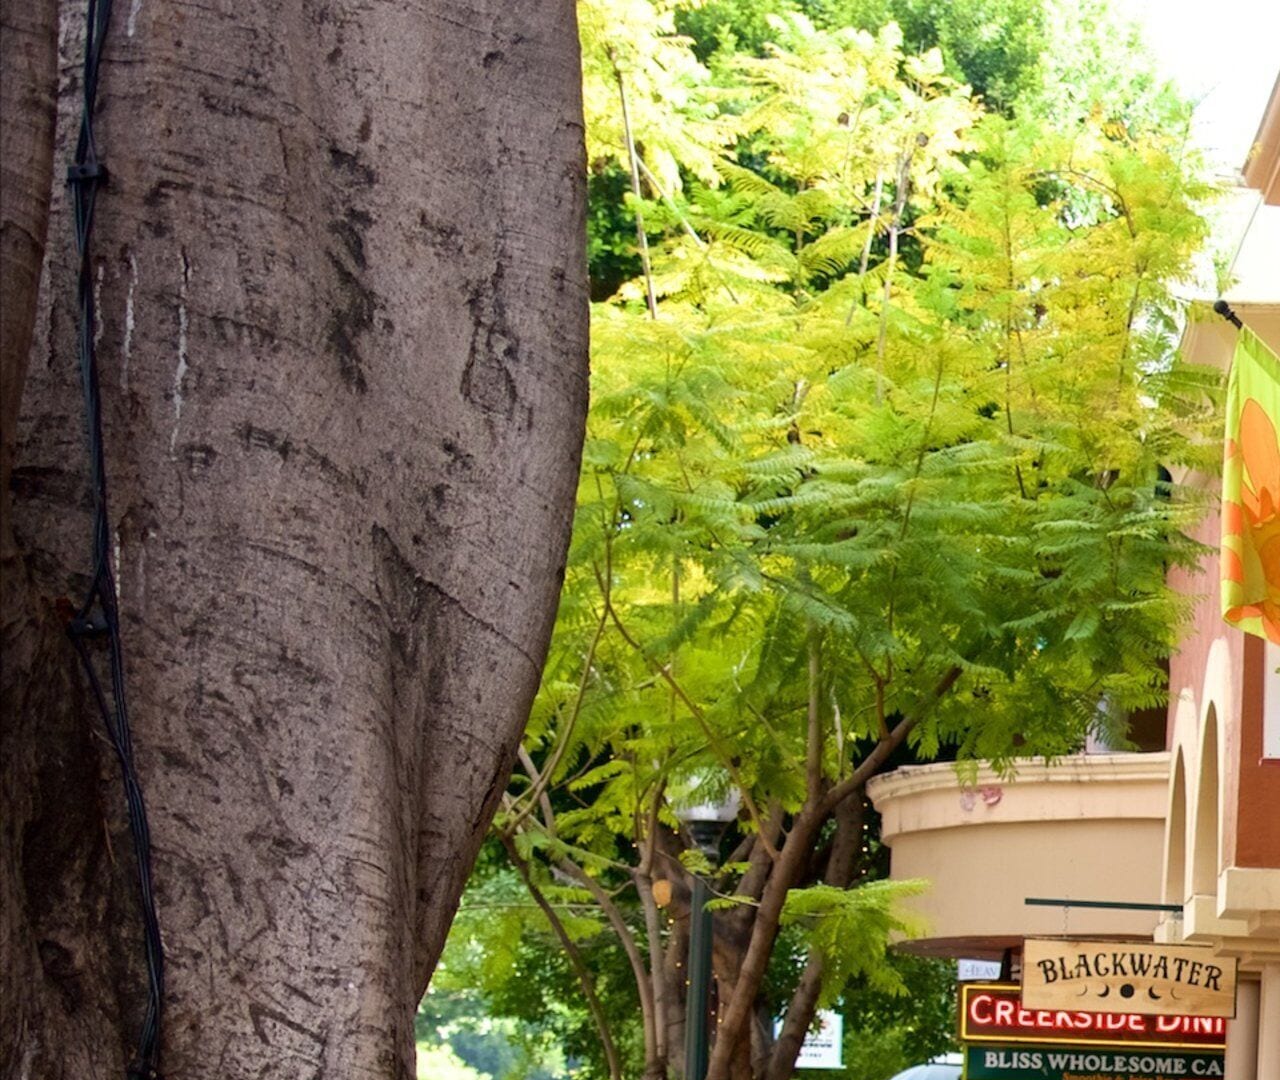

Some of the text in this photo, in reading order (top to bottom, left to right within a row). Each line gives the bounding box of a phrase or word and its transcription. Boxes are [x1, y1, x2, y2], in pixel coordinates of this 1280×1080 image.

[1037, 952, 1224, 991] BLACKWATER
[985, 1052, 1224, 1076] BLISS WHOLESOME CA
